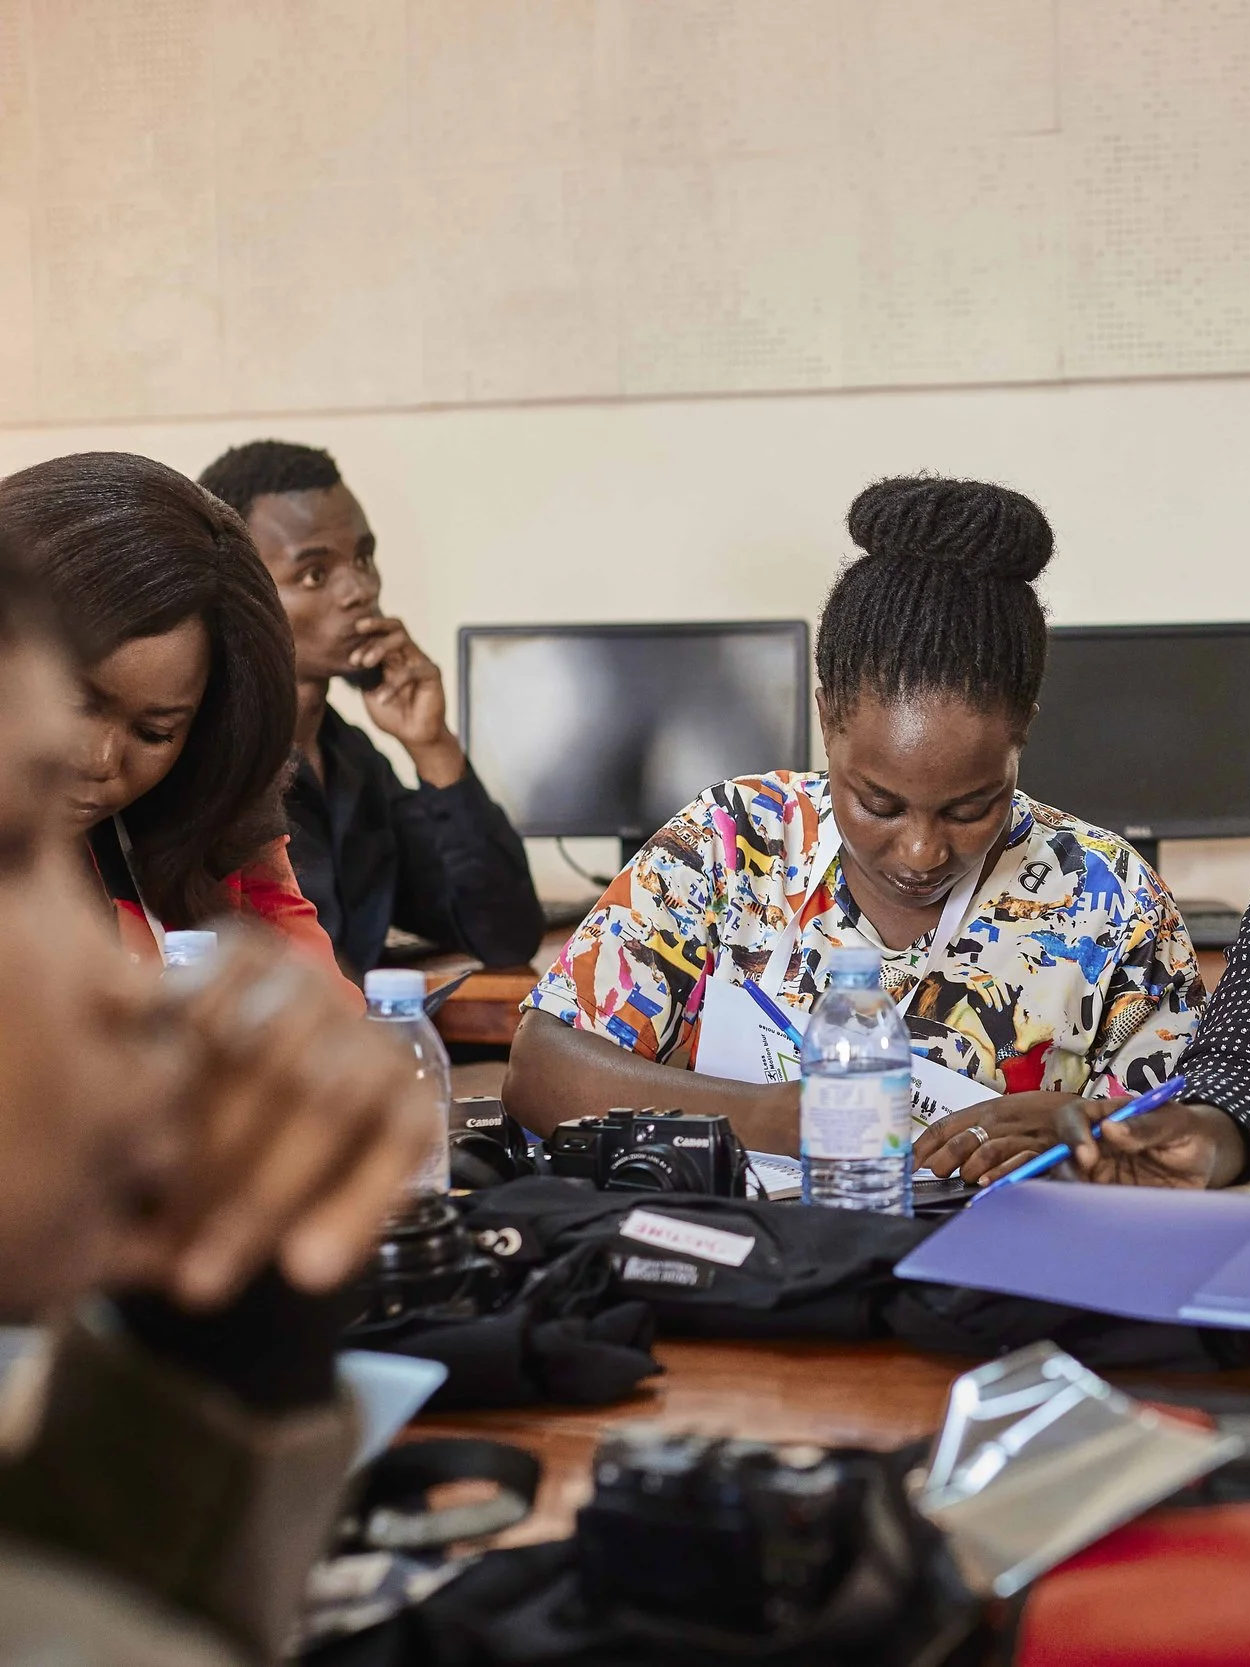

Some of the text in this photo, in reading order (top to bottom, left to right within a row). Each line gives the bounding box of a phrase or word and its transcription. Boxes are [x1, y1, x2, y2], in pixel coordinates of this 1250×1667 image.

[758, 1024, 776, 1034] noise
[760, 1033, 775, 1070] Motion blur
[761, 1055, 769, 1071] Less
[466, 1117, 503, 1129] Canon
[672, 1136, 710, 1148] Canon
